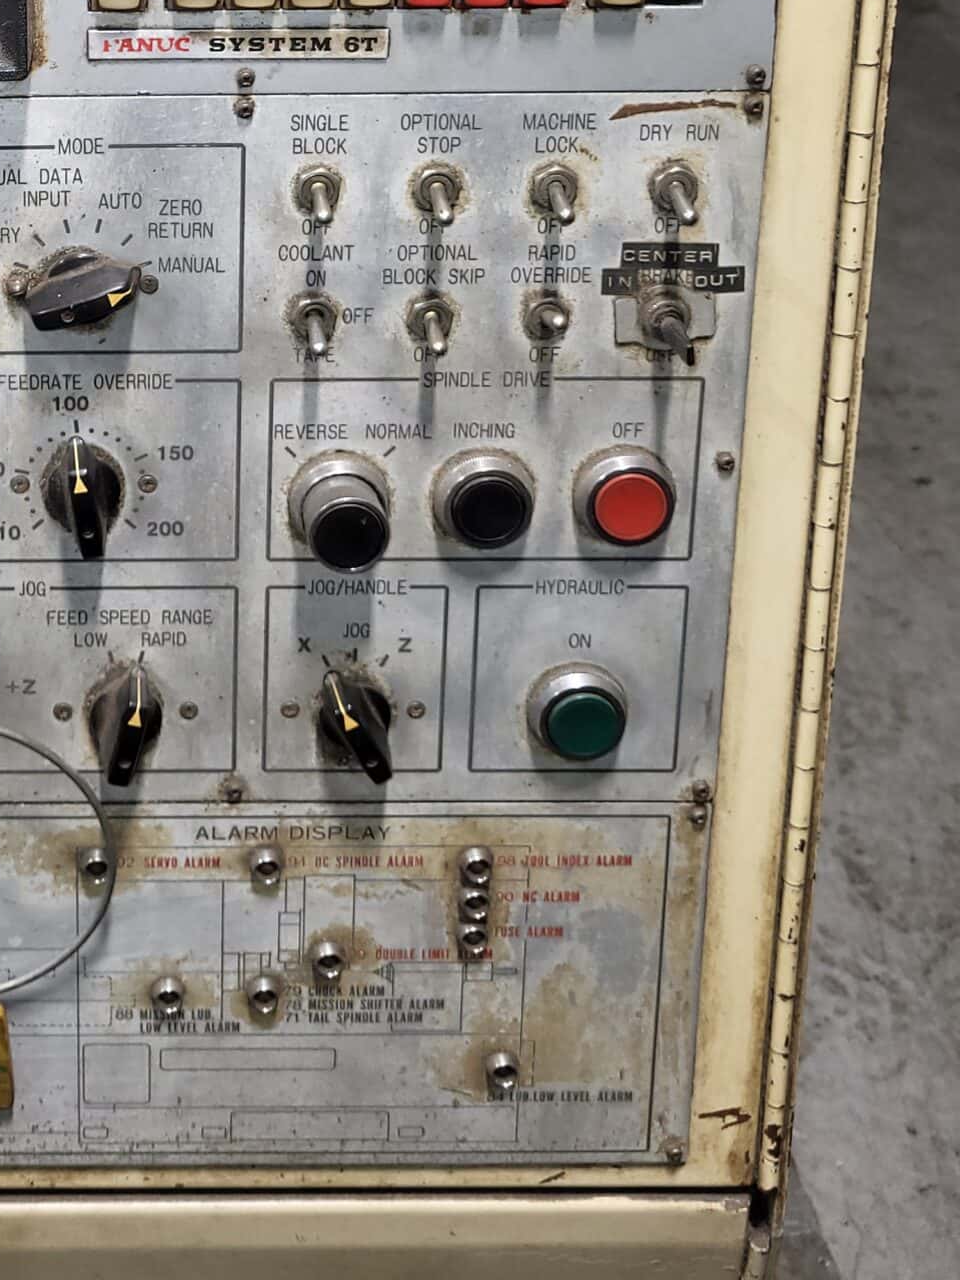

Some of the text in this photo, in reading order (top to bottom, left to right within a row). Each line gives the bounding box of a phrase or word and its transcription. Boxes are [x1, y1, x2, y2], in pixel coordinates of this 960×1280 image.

[209, 36, 378, 52] SYSTEM 6T
[290, 114, 349, 132] SINGLE
[400, 113, 483, 131] OPTIONAL
[523, 113, 597, 130] MACHINE
[640, 124, 719, 141] DRY RUN
[58, 138, 105, 155] MODE
[292, 137, 348, 154] BLOCK
[417, 136, 461, 153] STOP
[535, 136, 579, 153] LOCK
[39, 168, 83, 186] DATA
[23, 191, 71, 207] INPUT
[99, 192, 142, 209] AUTO
[159, 199, 202, 216] ZERO
[148, 222, 214, 239] RETURN
[278, 245, 355, 262] COOLANT
[397, 245, 478, 261] OPTIONAL
[528, 245, 576, 261] RAPID
[623, 249, 713, 263] CENTER
[158, 257, 226, 274] MANUAL
[305, 270, 326, 287] ON
[383, 268, 485, 285] BLOCK SKIP
[511, 266, 592, 283] OVERRIDE
[608, 276, 632, 288] IN
[695, 273, 738, 288] OUT
[343, 307, 374, 325] OFF
[529, 347, 561, 363] OFF
[94, 373, 173, 390] OVERRIDE
[423, 371, 550, 389] SPINDLE DRIVE
[52, 396, 89, 411] 100
[274, 423, 348, 440] REVERSE
[365, 423, 432, 440] NORMAL
[452, 422, 515, 440] INCHING
[612, 422, 644, 439] OFF
[158, 446, 194, 460] 150
[147, 521, 184, 536] 200
[19, 581, 47, 597] JOG
[307, 579, 408, 597] JOG/HANDLE
[535, 578, 625, 596] HYDRAULIC
[46, 609, 213, 626] FEED SPEED RANGE
[343, 623, 370, 639] JOG
[74, 632, 107, 647] LOW
[141, 632, 187, 647] RAPID
[298, 638, 311, 653] X
[399, 638, 412, 652] Z
[569, 633, 591, 649] ON
[195, 825, 390, 840] ALARM DISPLAY
[184, 857, 221, 868] ALARM
[336, 856, 423, 868] SPINDLE ALARM
[557, 855, 632, 866] INDEX ALARM
[544, 891, 580, 902] ALARM
[528, 926, 563, 937] ALARM
[349, 986, 385, 997] ALARM
[308, 999, 445, 1010] MISSION SHIFTER ALARM
[308, 1012, 423, 1024] TAIL SPINDLE ALARM
[140, 1022, 240, 1033] LOW LEVEL ALARM
[561, 1091, 633, 1102] LEVEL ALARM
